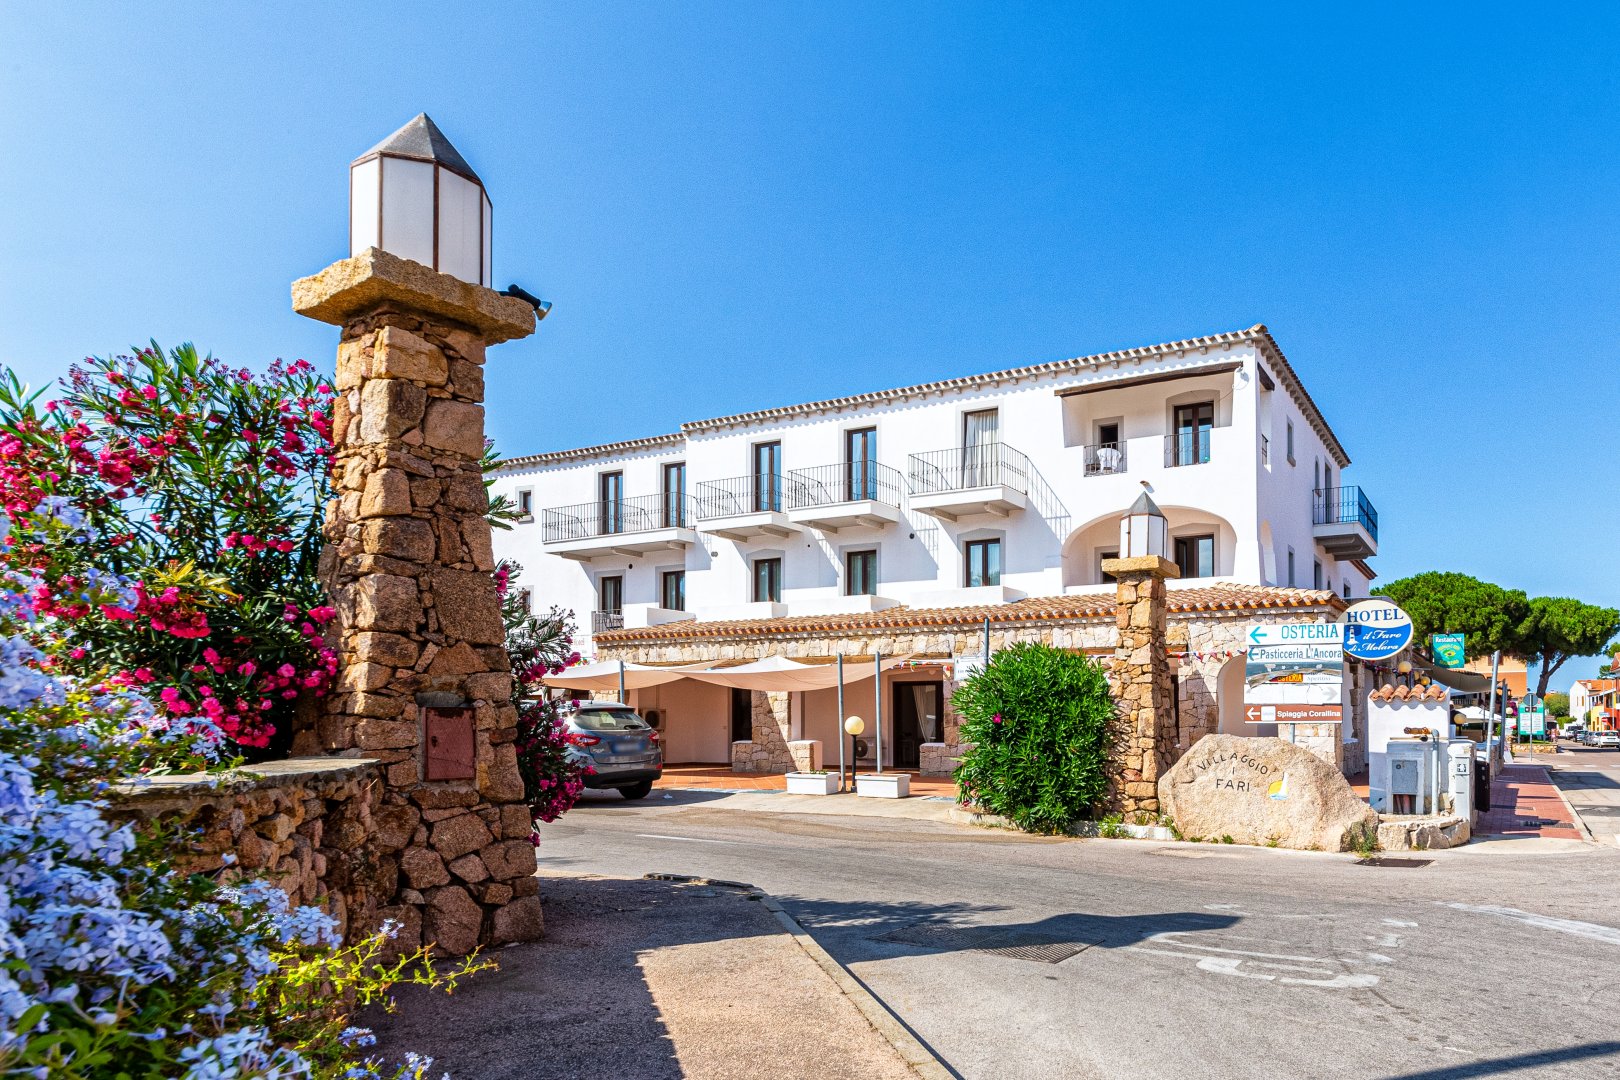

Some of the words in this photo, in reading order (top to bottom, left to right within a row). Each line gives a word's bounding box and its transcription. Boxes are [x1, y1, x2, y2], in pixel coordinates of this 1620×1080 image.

[1347, 609, 1404, 622] HOTEL
[1282, 624, 1339, 639] OSTERIA
[1362, 632, 1372, 640] il
[1372, 630, 1402, 640] Faro
[1348, 644, 1358, 652] di
[1358, 640, 1399, 651] Molara
[1260, 648, 1303, 658] Pasticceria
[1306, 648, 1342, 658] L'Ancora
[1277, 710, 1308, 718] Spiaggia
[1196, 752, 1268, 774] VILLAGGIO
[1216, 778, 1250, 792] FARI
